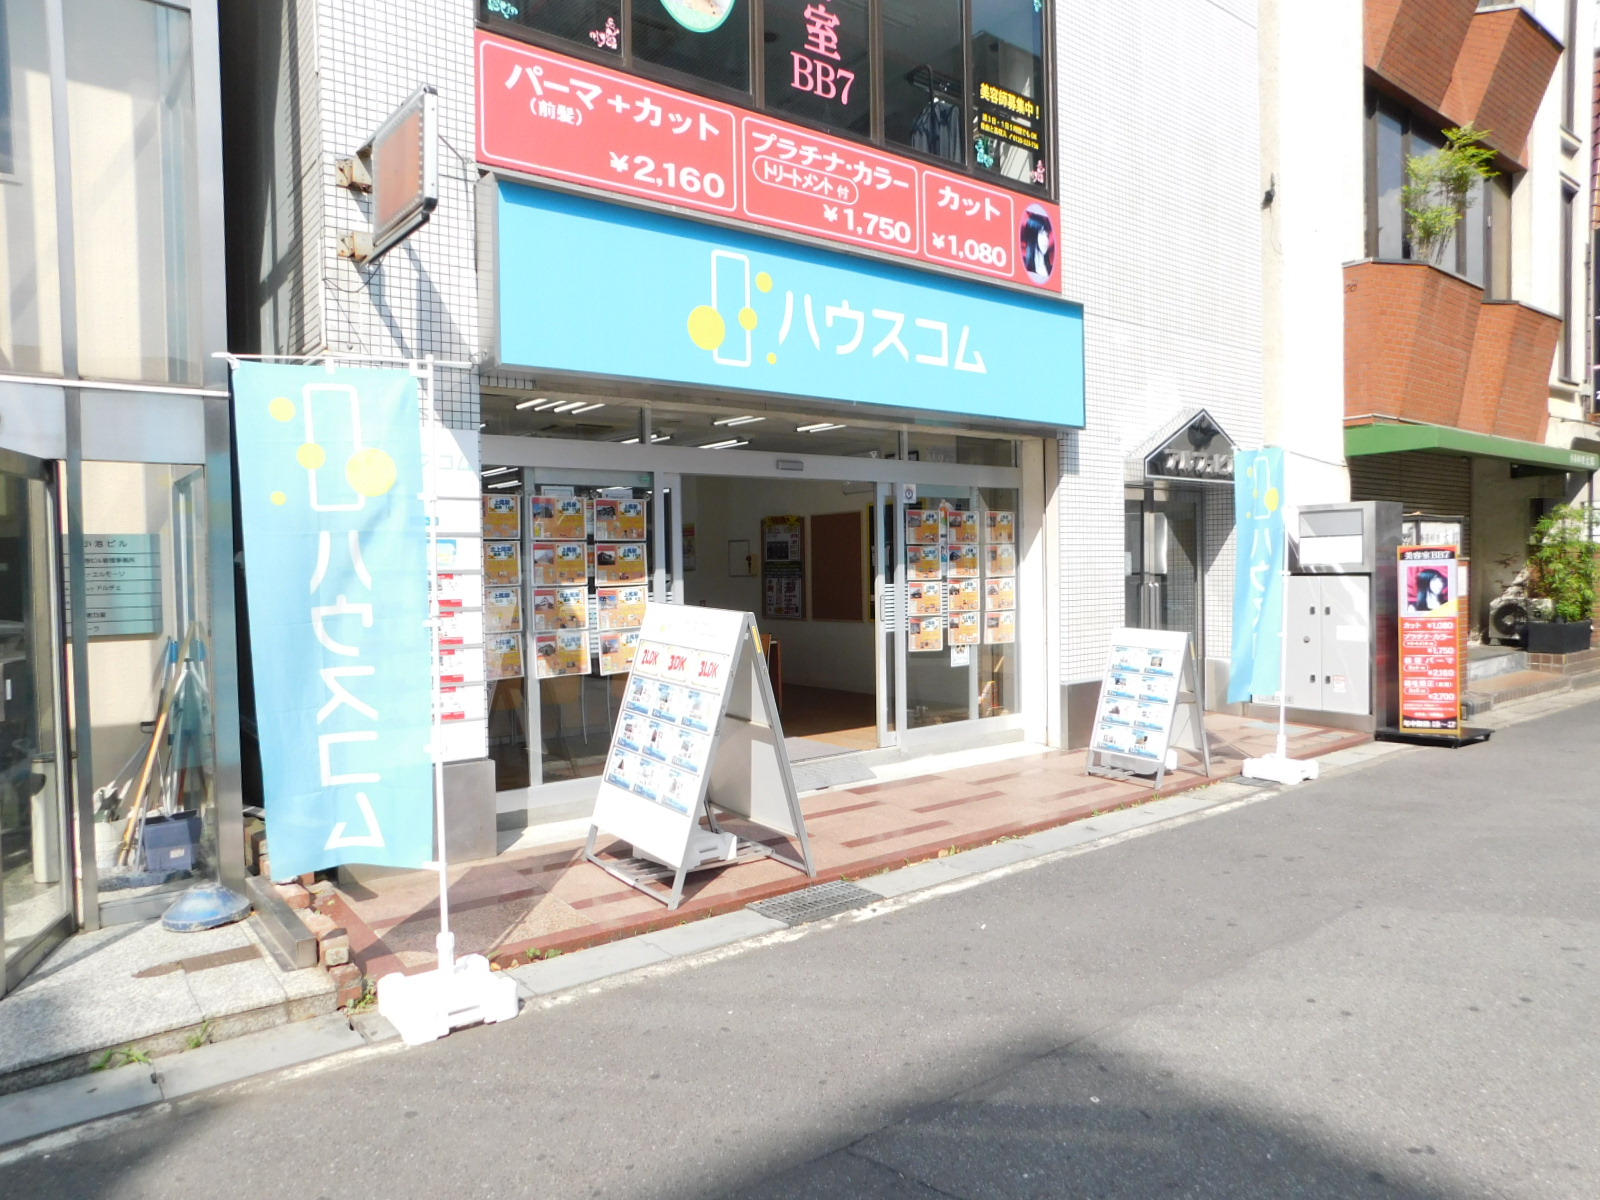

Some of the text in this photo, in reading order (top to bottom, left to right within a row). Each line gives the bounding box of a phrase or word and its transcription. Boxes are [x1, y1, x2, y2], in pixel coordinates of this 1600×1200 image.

[803, 3, 841, 61] 室
[790, 51, 855, 105] BB7
[609, 151, 725, 198] ¥2,160
[752, 132, 909, 190] プラチナ・カラー
[823, 204, 912, 244] ¥1,750
[937, 185, 1001, 221] カット
[931, 232, 1007, 268] ¥1,080
[778, 290, 988, 374] ハウスコム
[667, 654, 687, 671] 3DK
[698, 660, 719, 678] 3LDK
